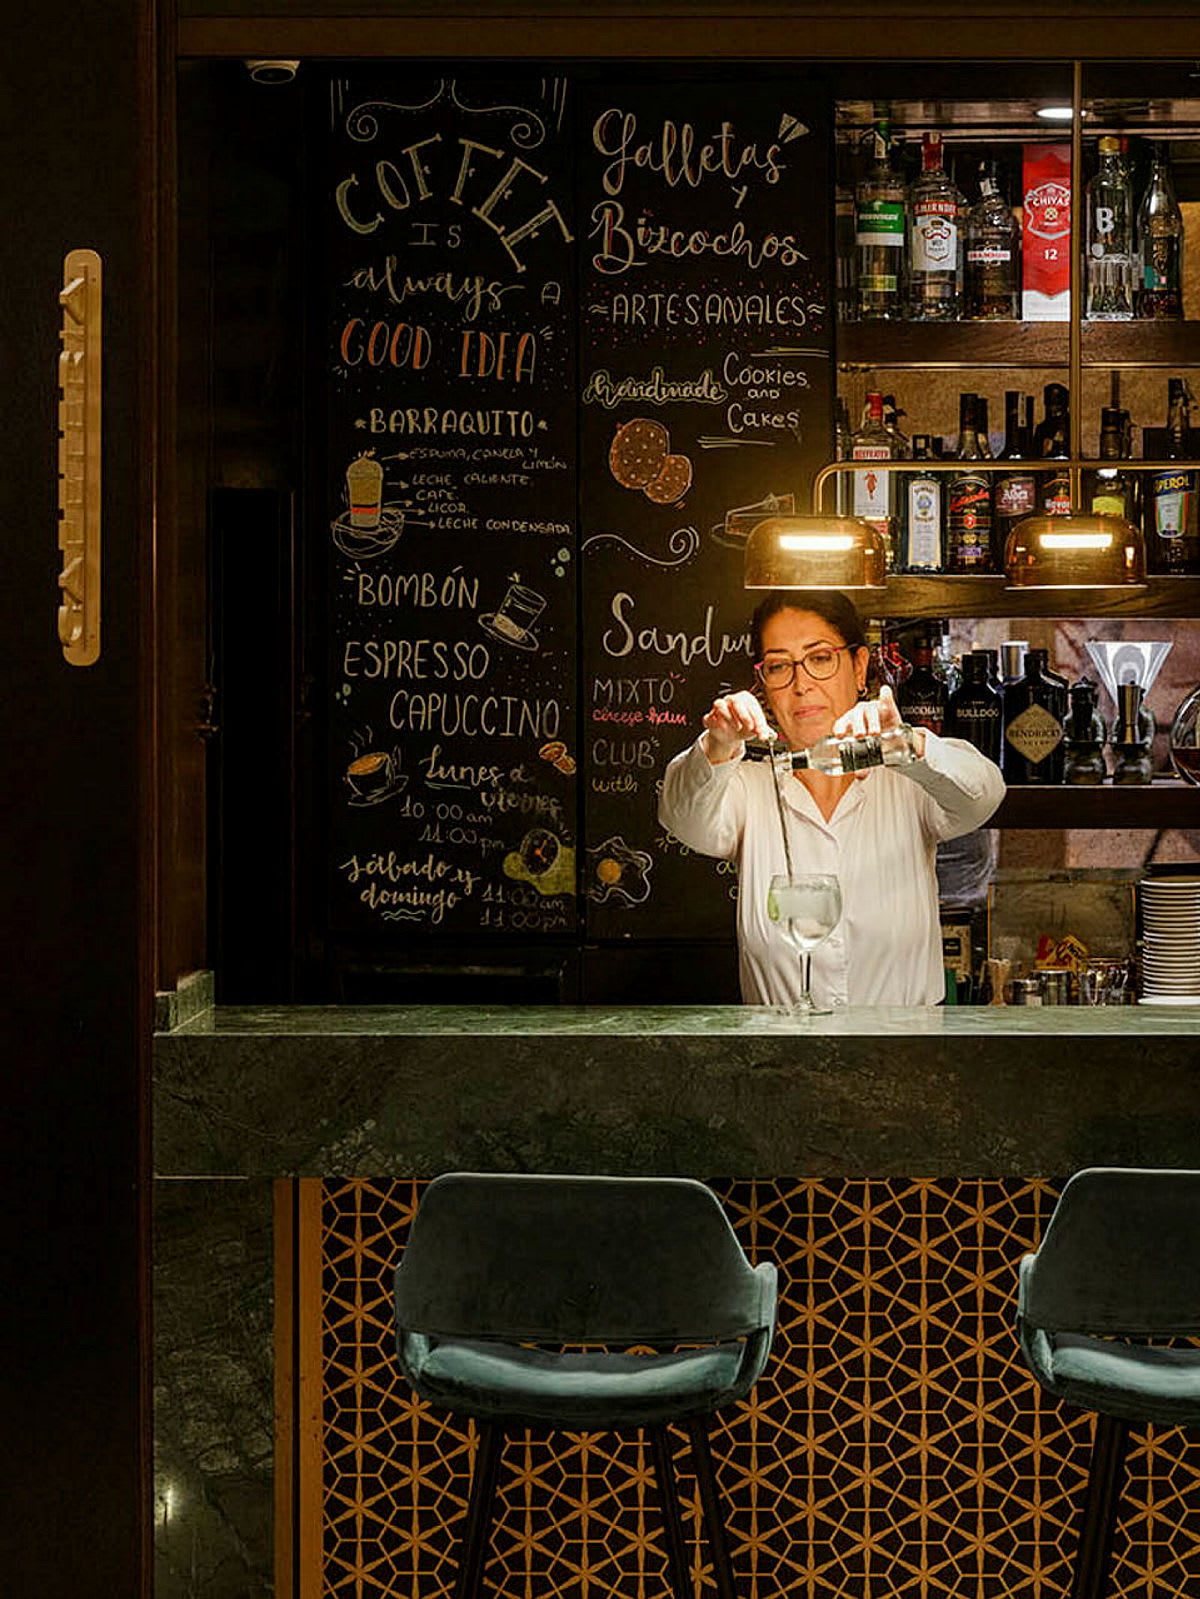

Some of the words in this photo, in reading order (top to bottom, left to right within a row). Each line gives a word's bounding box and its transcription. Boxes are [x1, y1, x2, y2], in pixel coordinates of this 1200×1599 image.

[593, 108, 787, 195] Galletas
[336, 132, 575, 273] COFFEE
[1033, 195, 1070, 207] CHIVAS
[408, 223, 461, 248] IS
[588, 200, 810, 274] Bizcochos
[1044, 249, 1058, 261] 12
[342, 255, 526, 322] always
[613, 293, 807, 328] ARTESANALES
[341, 318, 432, 371] GOOD
[458, 330, 537, 384] IDEA
[583, 367, 728, 408] handmade
[723, 351, 809, 388] Cookies
[369, 407, 534, 437] BARRAQUITO
[727, 403, 801, 434] Cakes
[412, 472, 452, 486] LECHE
[438, 517, 479, 530] LECHE
[358, 565, 479, 609] BOMBÓN
[603, 592, 755, 667] Sandwi
[344, 639, 490, 681] ESPRESSO
[593, 679, 675, 705] MIXTO
[389, 689, 560, 739] CAPUCCINO
[956, 708, 1000, 718] BULLDOG
[593, 737, 656, 769] CLUB
[593, 775, 639, 794] with
[450, 867, 482, 895] y
[360, 883, 463, 924] domingo
